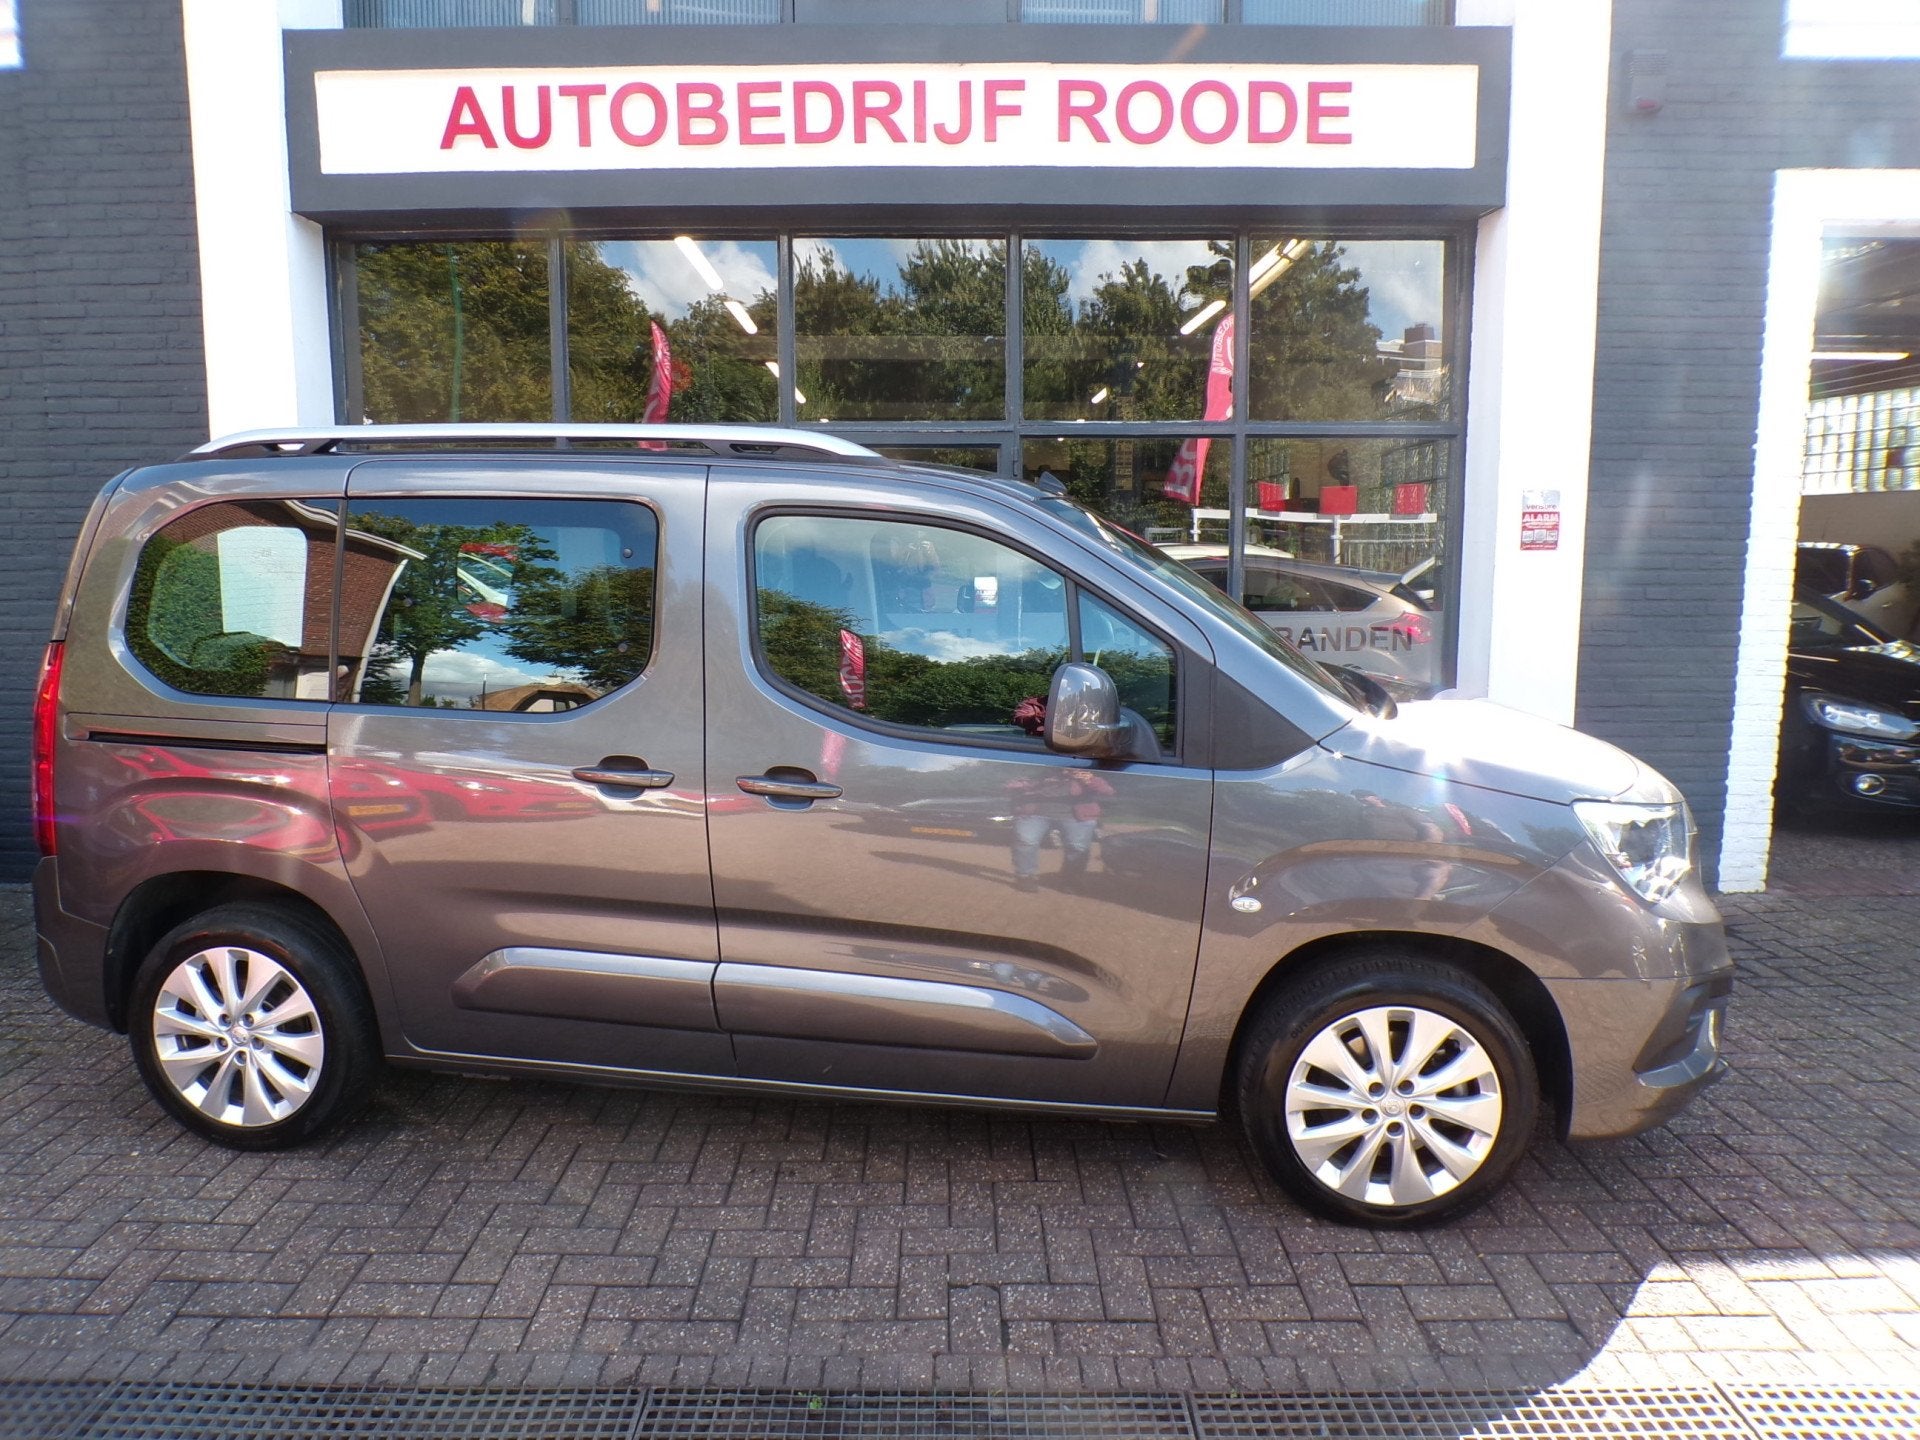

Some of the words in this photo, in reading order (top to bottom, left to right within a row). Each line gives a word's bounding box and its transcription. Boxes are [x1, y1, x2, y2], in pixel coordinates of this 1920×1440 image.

[440, 79, 1026, 150] AUTOBEDRIJF
[1057, 79, 1353, 145] ROODE
[1522, 513, 1559, 523] ALARM
[1273, 626, 1413, 652] BANDEN
